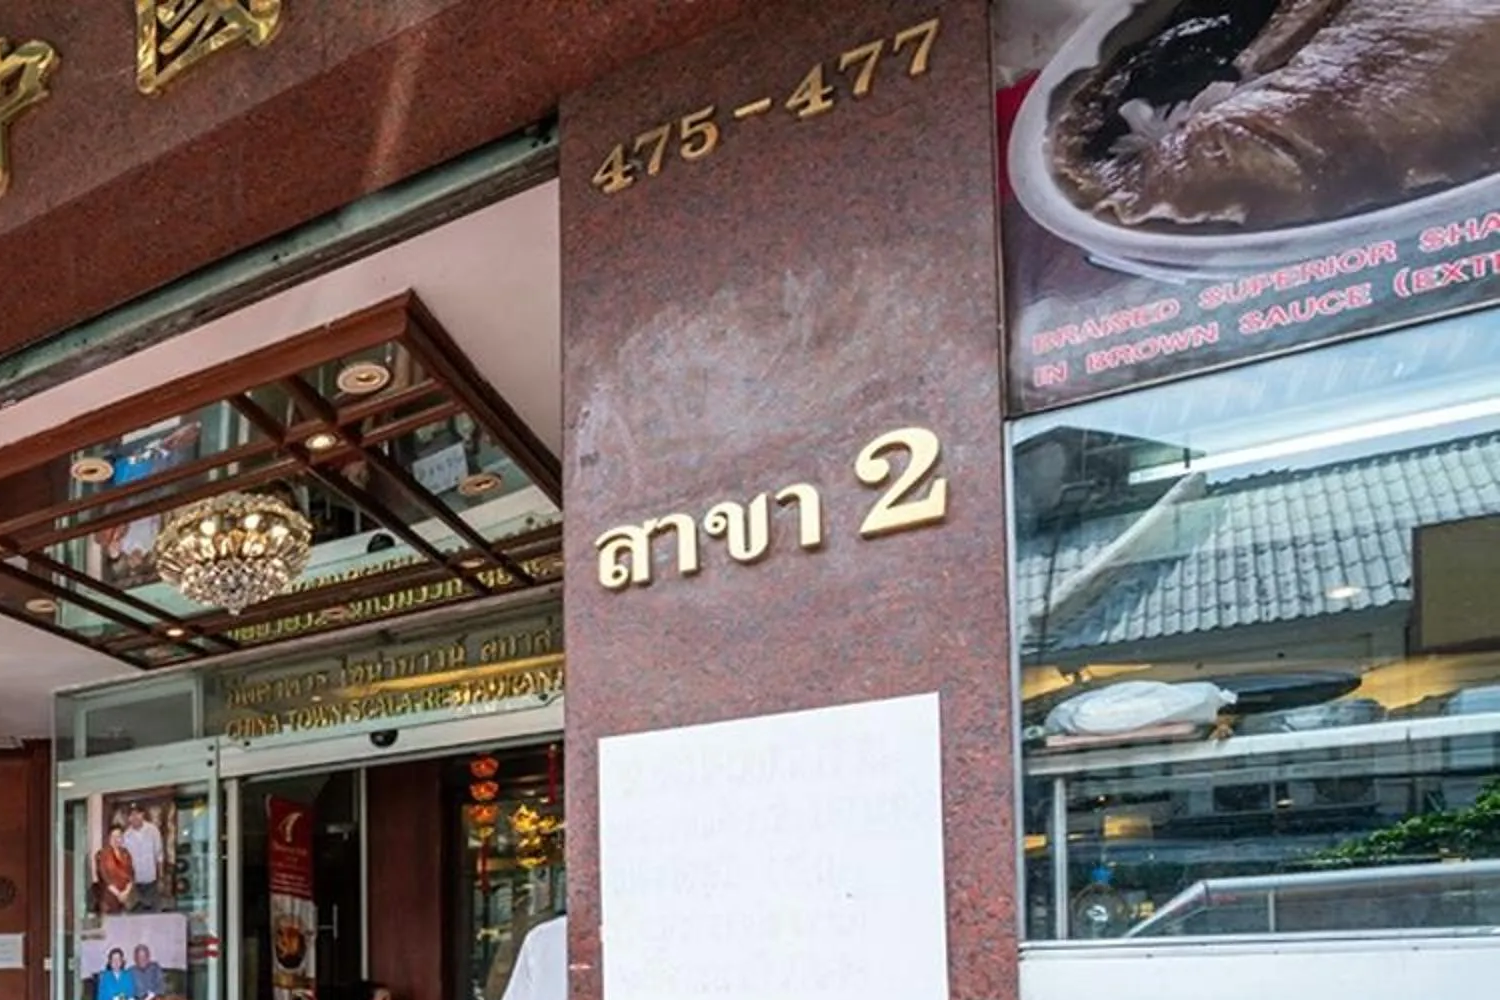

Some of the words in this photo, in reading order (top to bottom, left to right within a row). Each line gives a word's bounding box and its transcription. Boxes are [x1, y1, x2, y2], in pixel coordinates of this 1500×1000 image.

[1198, 239, 1398, 311] SUPERIOR
[1033, 359, 1068, 388] IN
[1085, 320, 1219, 375] BROWN
[1238, 281, 1373, 335] SAUCE
[595, 482, 823, 592] สาขา
[854, 426, 949, 540] 2
